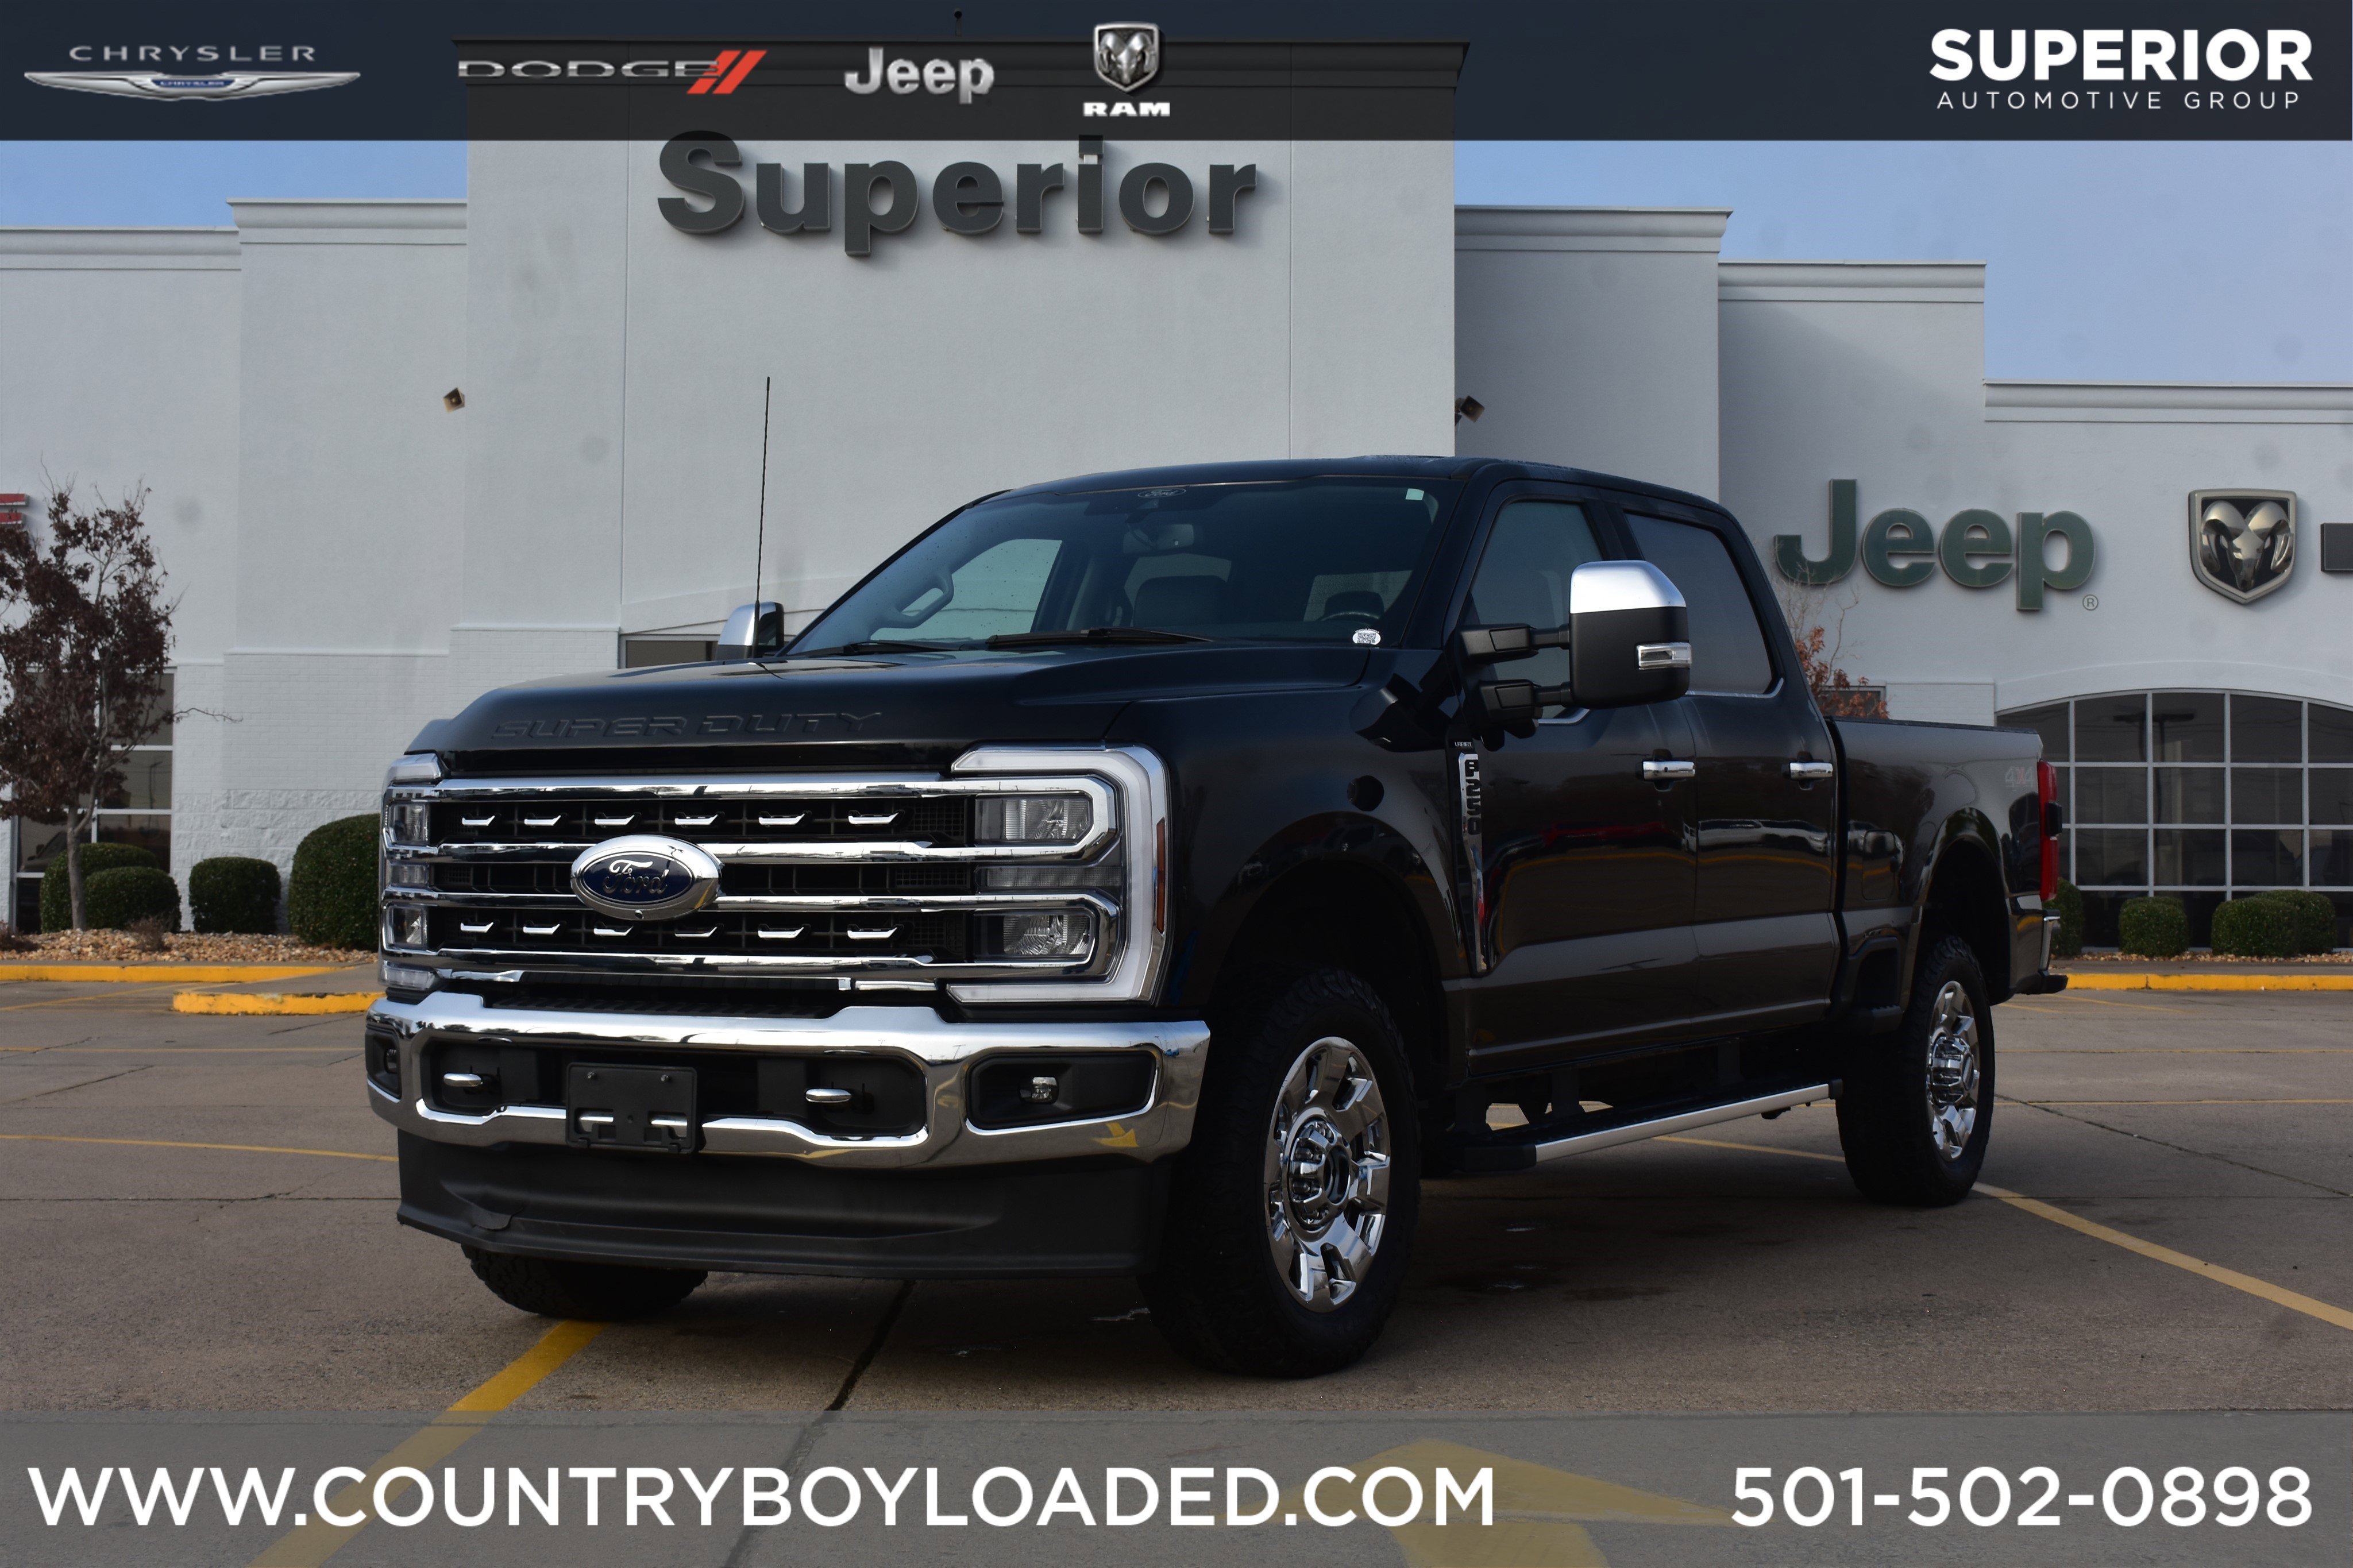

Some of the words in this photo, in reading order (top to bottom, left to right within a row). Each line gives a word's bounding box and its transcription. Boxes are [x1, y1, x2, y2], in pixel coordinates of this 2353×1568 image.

[658, 130, 1257, 257] Superior
[1774, 478, 2096, 610] Jeep
[490, 716, 688, 740] SUPER
[696, 711, 883, 736] DUTY
[603, 859, 670, 894] Ford
